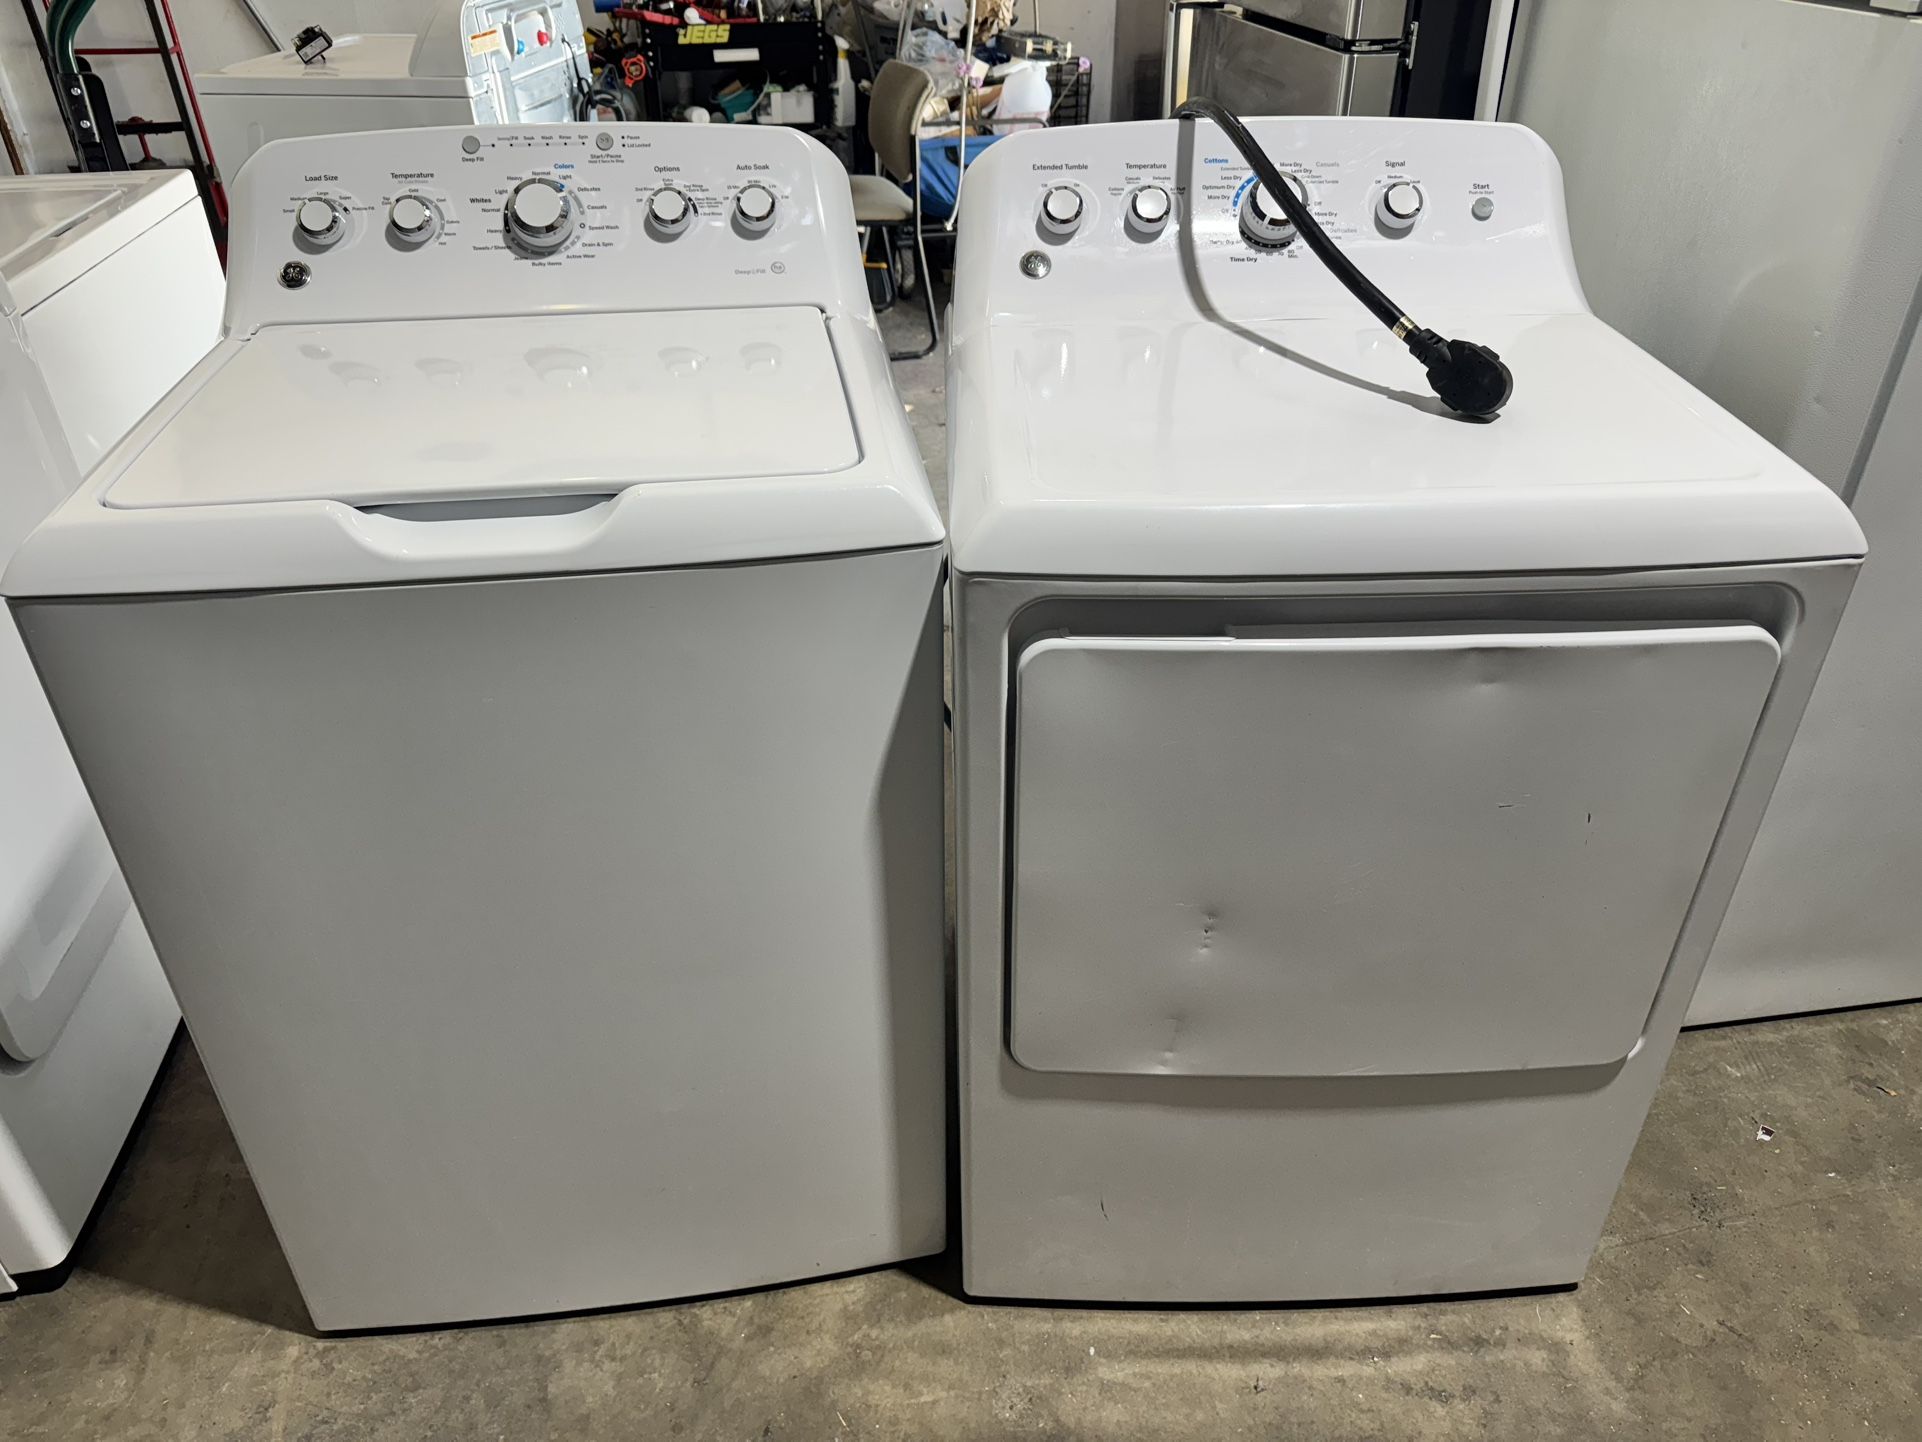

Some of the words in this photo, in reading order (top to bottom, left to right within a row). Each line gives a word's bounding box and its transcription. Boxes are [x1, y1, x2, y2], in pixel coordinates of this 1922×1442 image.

[677, 24, 730, 44] JEGS
[1032, 163, 1064, 171] Extended
[1064, 163, 1089, 171] Tumble
[1125, 162, 1167, 170] Temperature
[1385, 160, 1406, 168] Signal
[654, 165, 681, 174] Options
[323, 174, 339, 182] Size
[390, 172, 435, 180] Temperature
